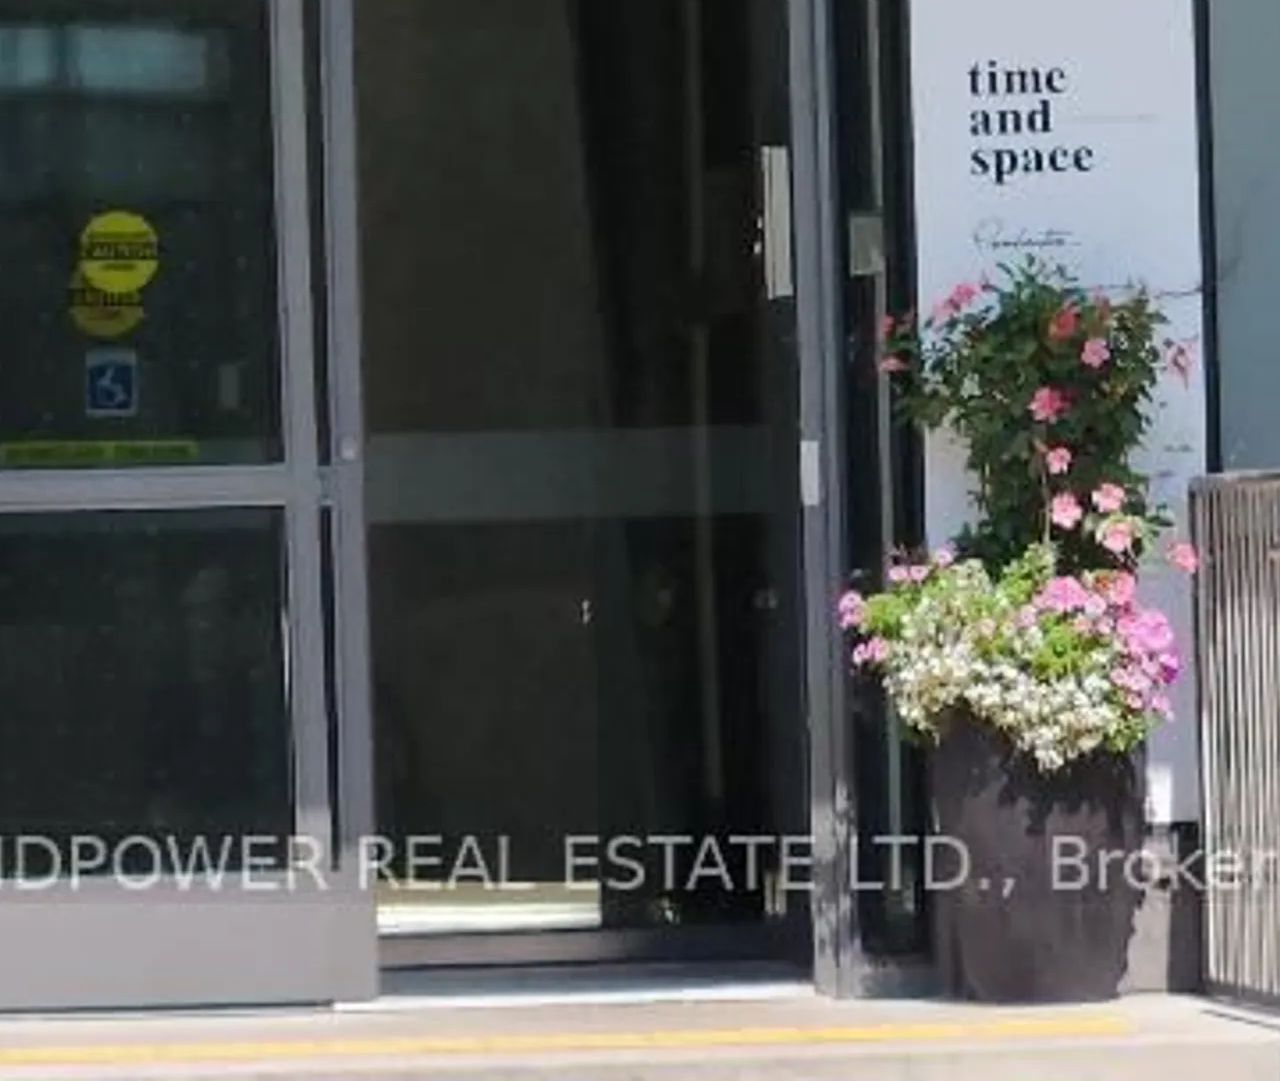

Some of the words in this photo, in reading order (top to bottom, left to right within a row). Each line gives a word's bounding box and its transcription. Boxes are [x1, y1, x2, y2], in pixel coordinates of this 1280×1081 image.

[967, 59, 1067, 96] time
[969, 98, 1052, 136] and
[969, 144, 1094, 186] space
